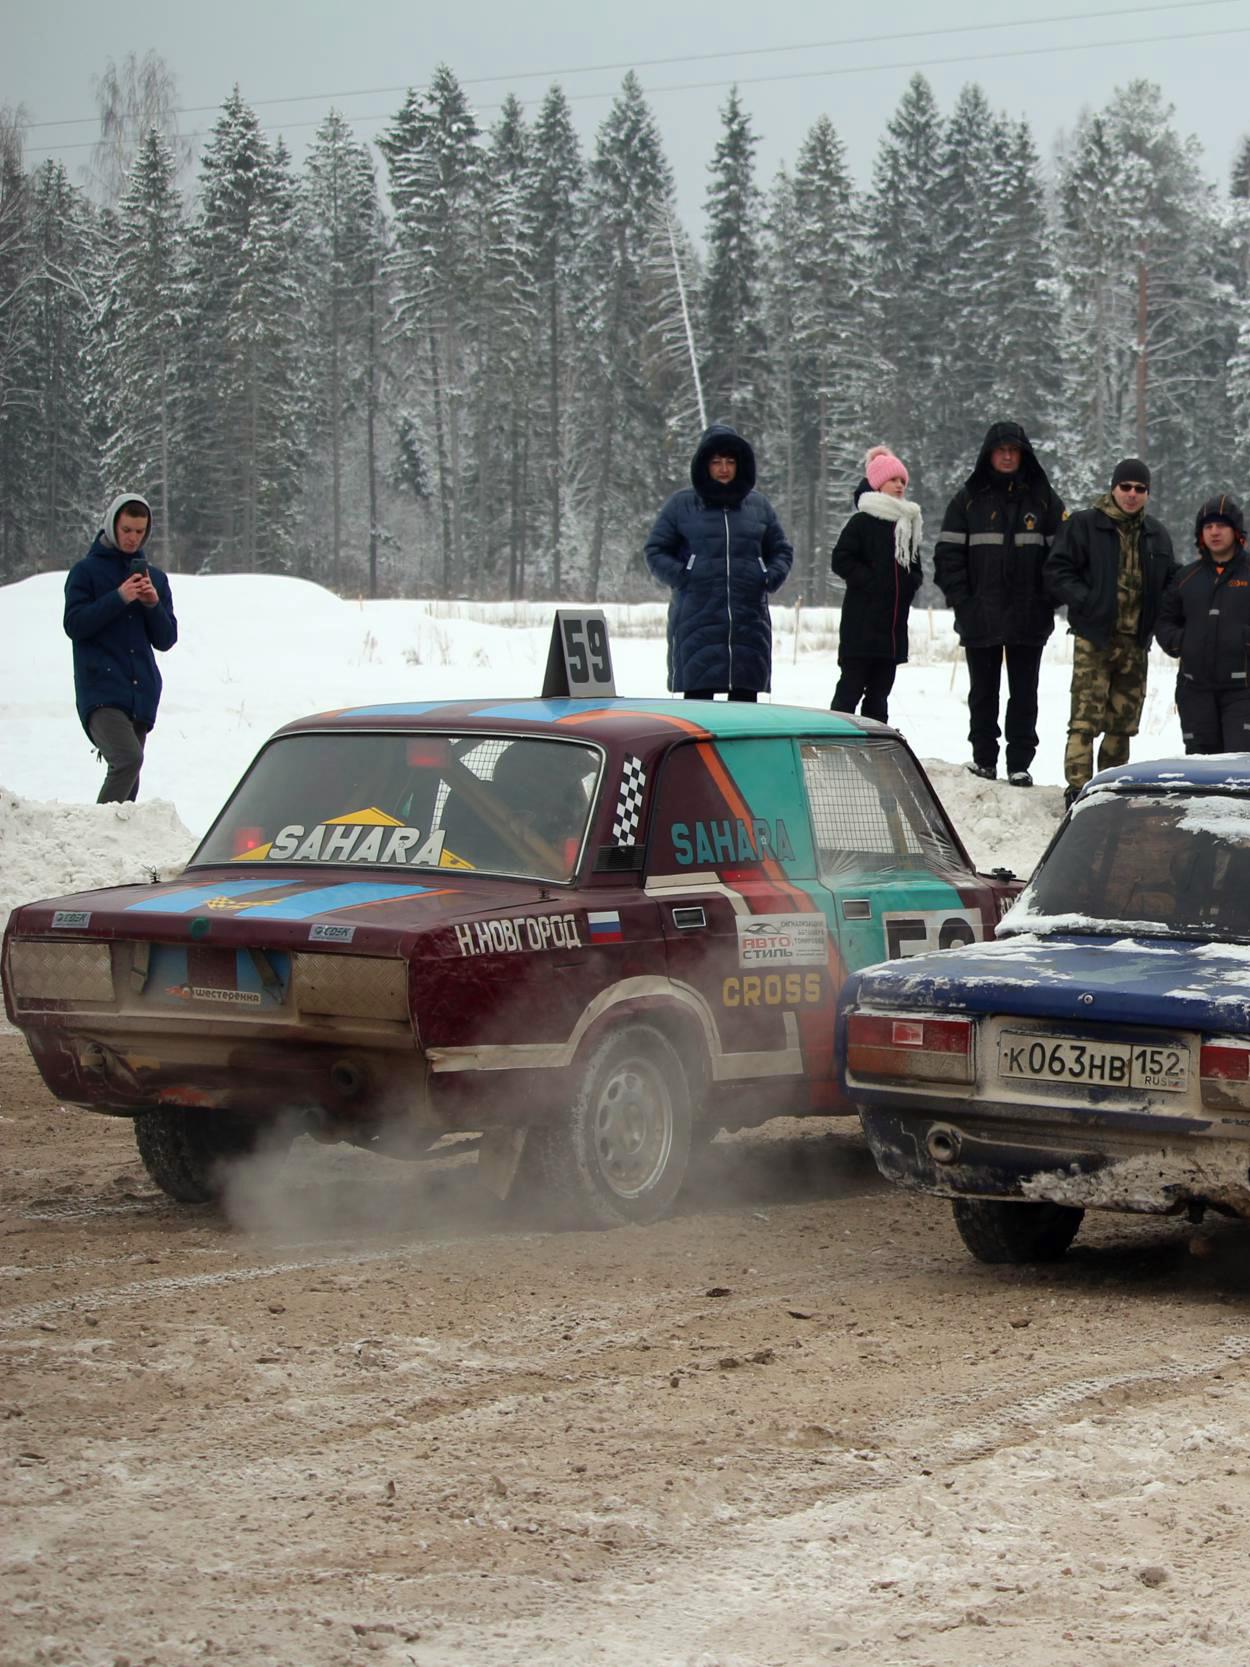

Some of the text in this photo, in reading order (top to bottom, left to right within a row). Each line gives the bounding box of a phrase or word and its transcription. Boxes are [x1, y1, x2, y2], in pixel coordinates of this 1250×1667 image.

[562, 619, 612, 683] 59
[269, 825, 446, 867] SAHARA
[671, 818, 796, 865] SAHARA
[454, 913, 582, 956] Н.НОВГОРОД
[743, 936, 790, 949] АВТО
[743, 949, 793, 960] СТИЛЬ
[723, 973, 820, 1007] CROSS
[1135, 1050, 1181, 1077] 152
[1144, 1075, 1168, 1087] RUS
